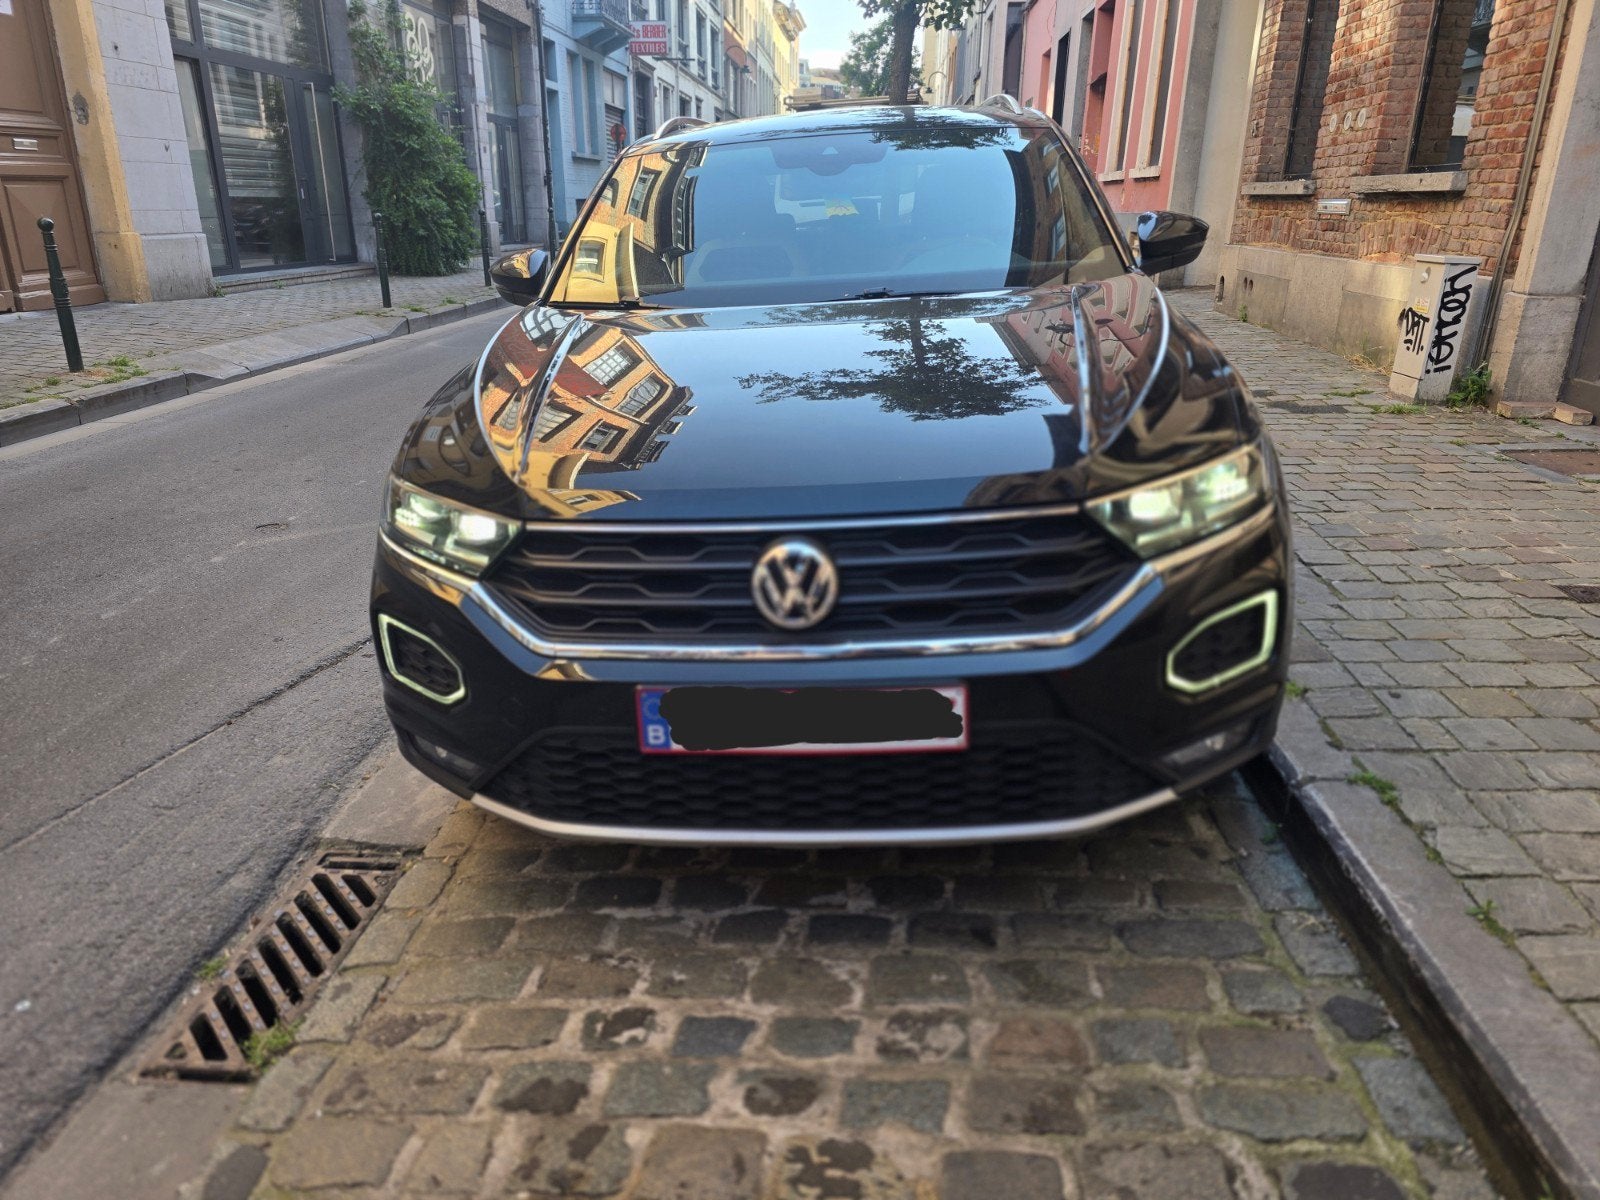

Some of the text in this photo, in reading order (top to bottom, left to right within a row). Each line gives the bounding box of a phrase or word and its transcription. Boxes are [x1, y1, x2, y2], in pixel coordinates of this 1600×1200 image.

[631, 42, 666, 53] TEXTILES
[752, 541, 838, 628] VW
[646, 723, 666, 746] B
